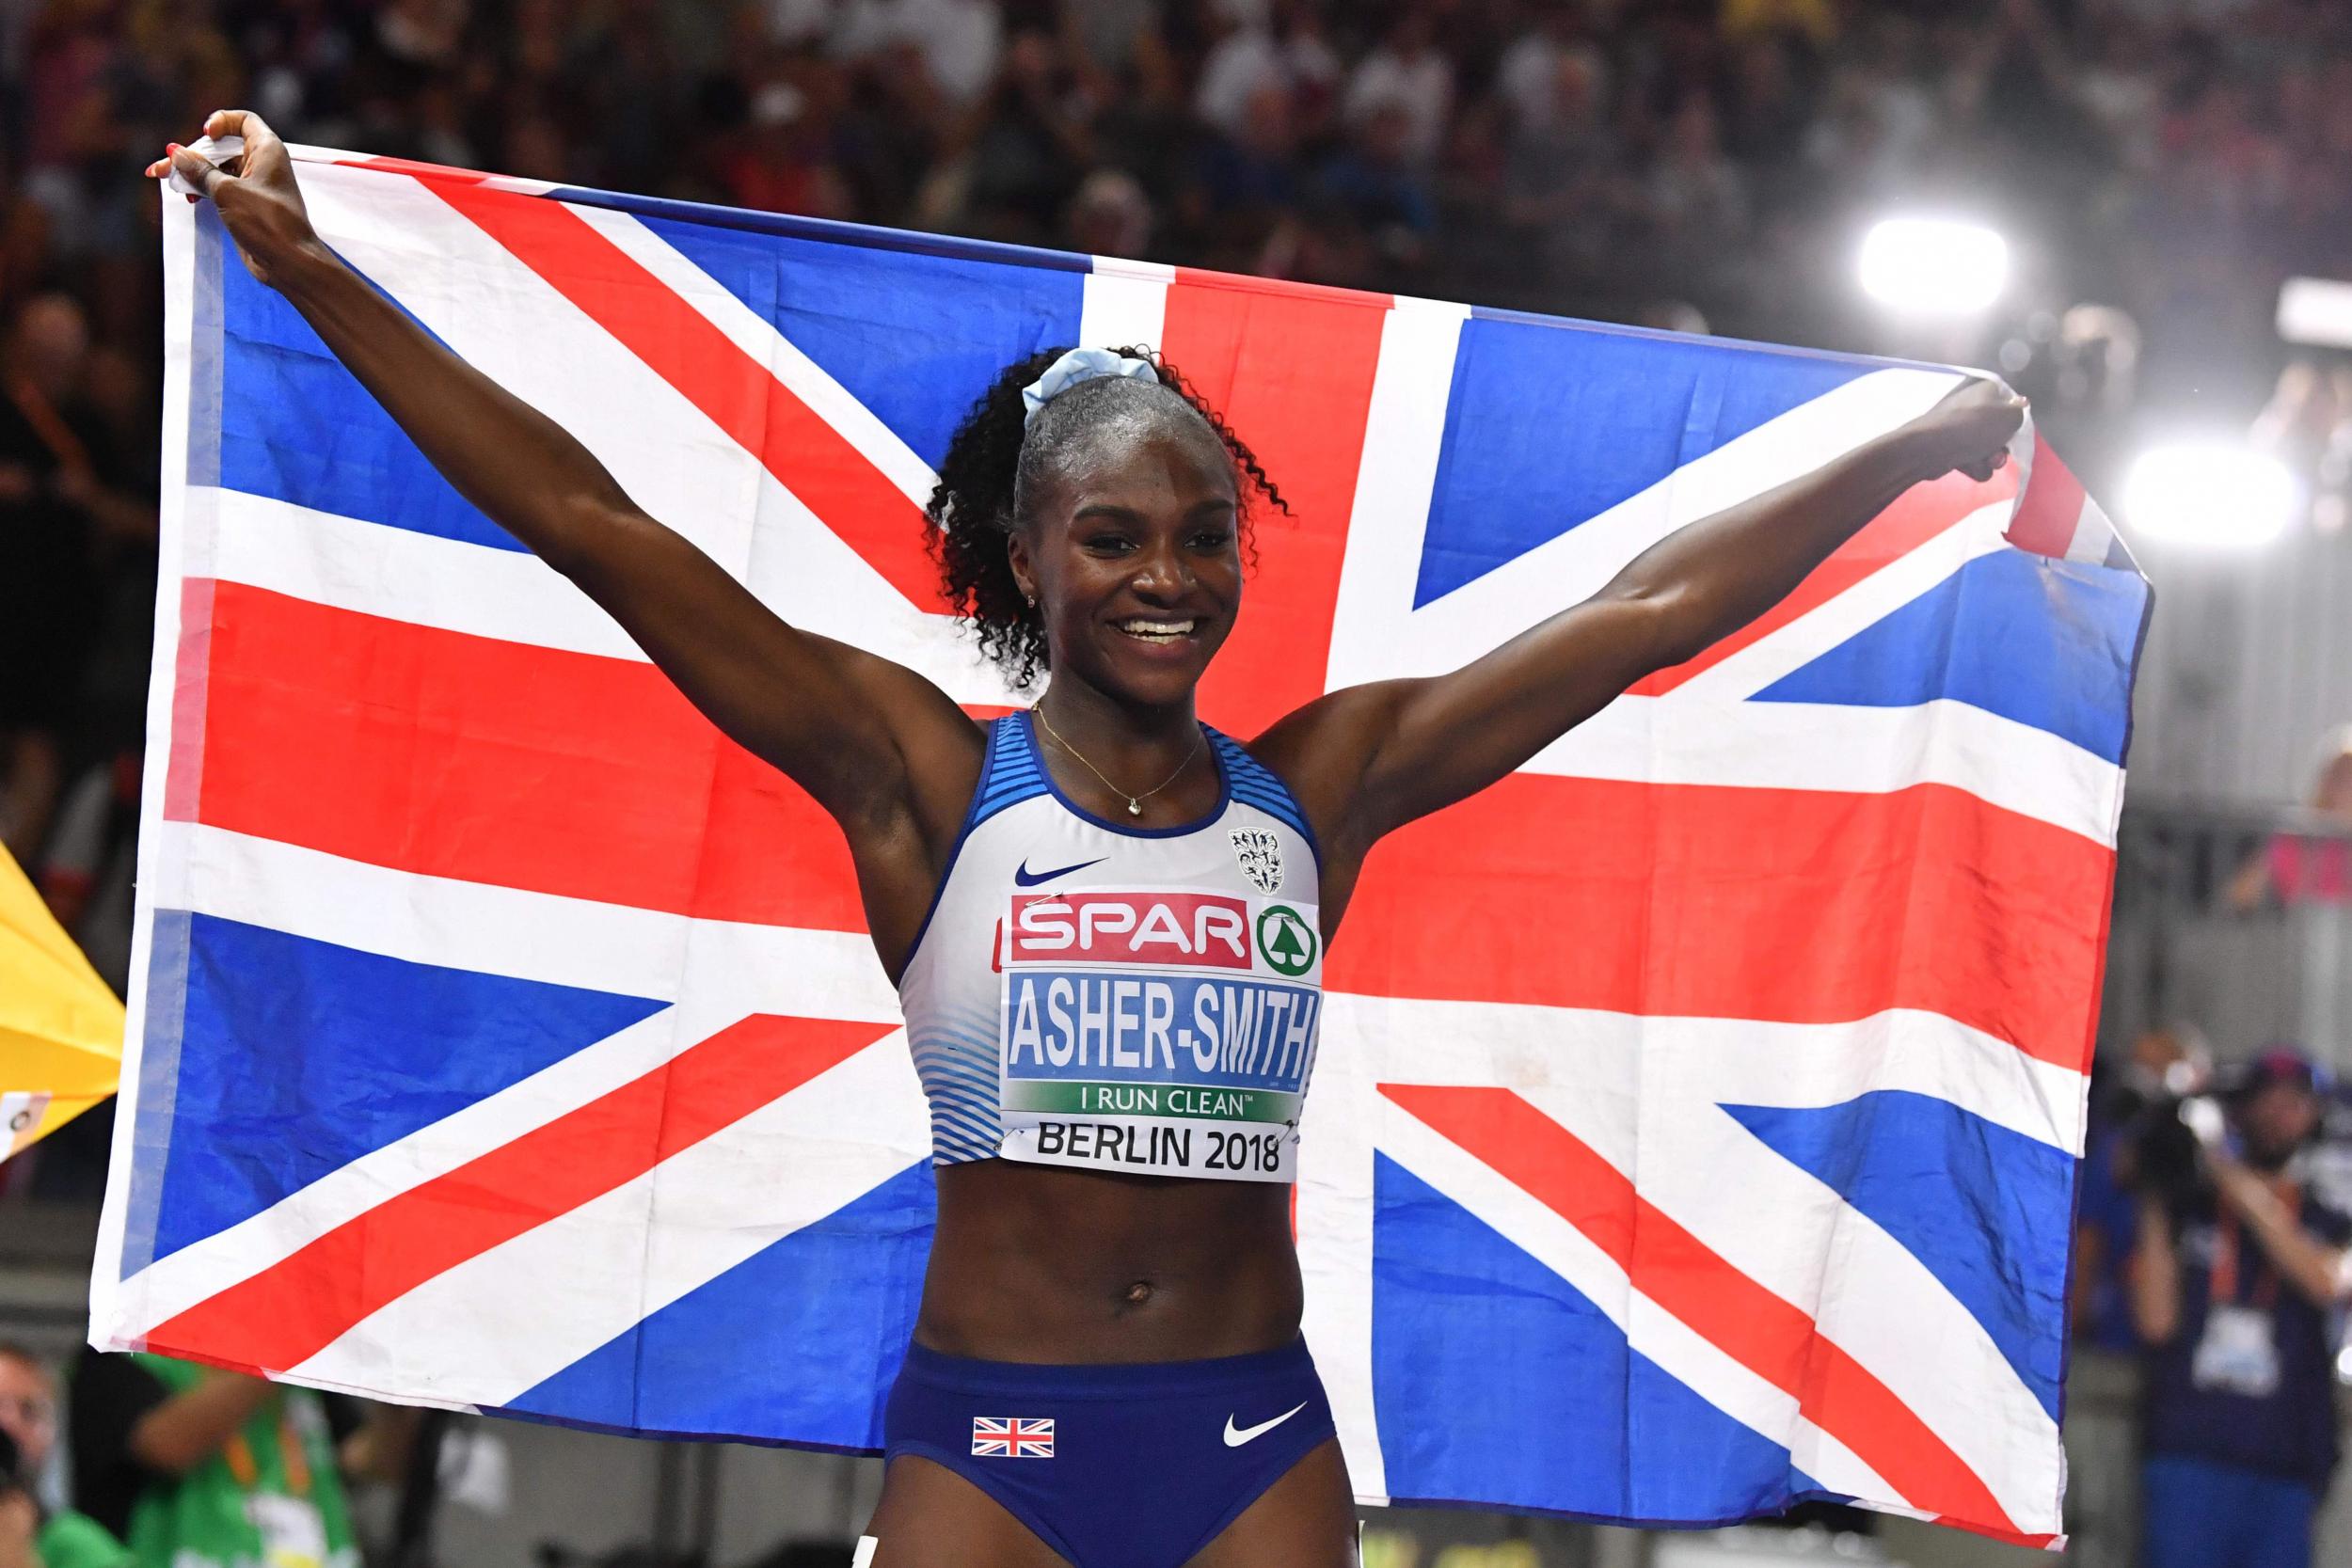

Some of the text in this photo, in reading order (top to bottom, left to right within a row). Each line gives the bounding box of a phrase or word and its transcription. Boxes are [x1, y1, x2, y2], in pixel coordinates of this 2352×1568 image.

[1019, 902, 1245, 958] SPAR
[1009, 976, 1315, 1079] ASHER-SMITH
[1081, 1086, 1087, 1109] I
[1098, 1087, 1158, 1112] RUN
[1037, 1121, 1279, 1172] BERLIN 2018
